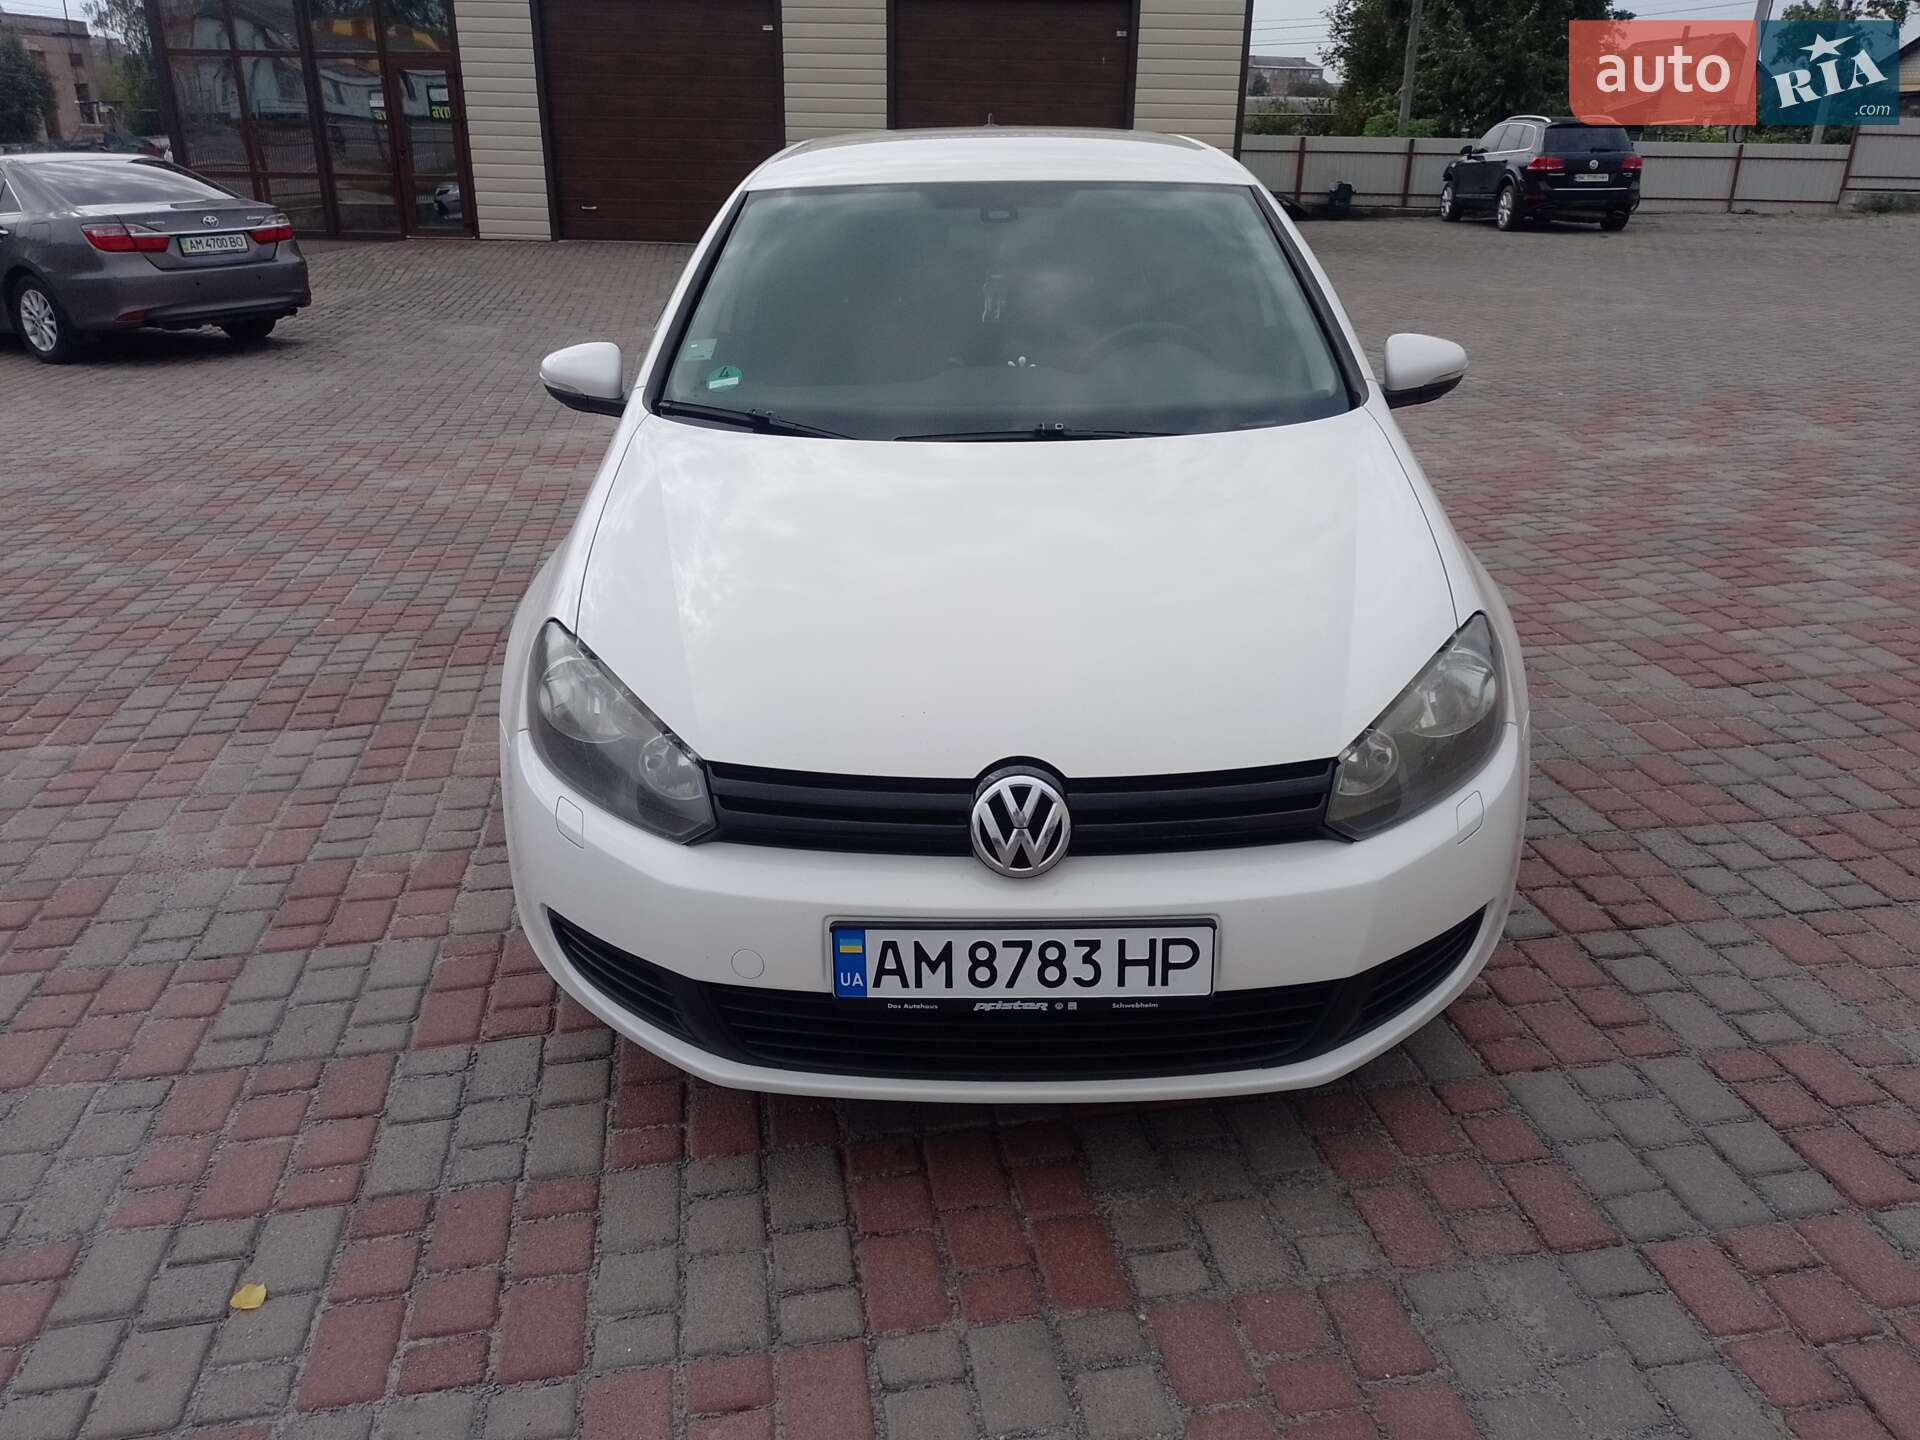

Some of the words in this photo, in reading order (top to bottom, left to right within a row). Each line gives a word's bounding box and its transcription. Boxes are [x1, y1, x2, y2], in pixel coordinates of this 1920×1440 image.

[189, 239, 203, 251] AM
[205, 237, 227, 250] 4700
[230, 236, 243, 248] BO
[871, 939, 954, 989] AM
[966, 938, 1102, 989] 8783
[1117, 937, 1201, 988] HP
[839, 972, 864, 987] UA
